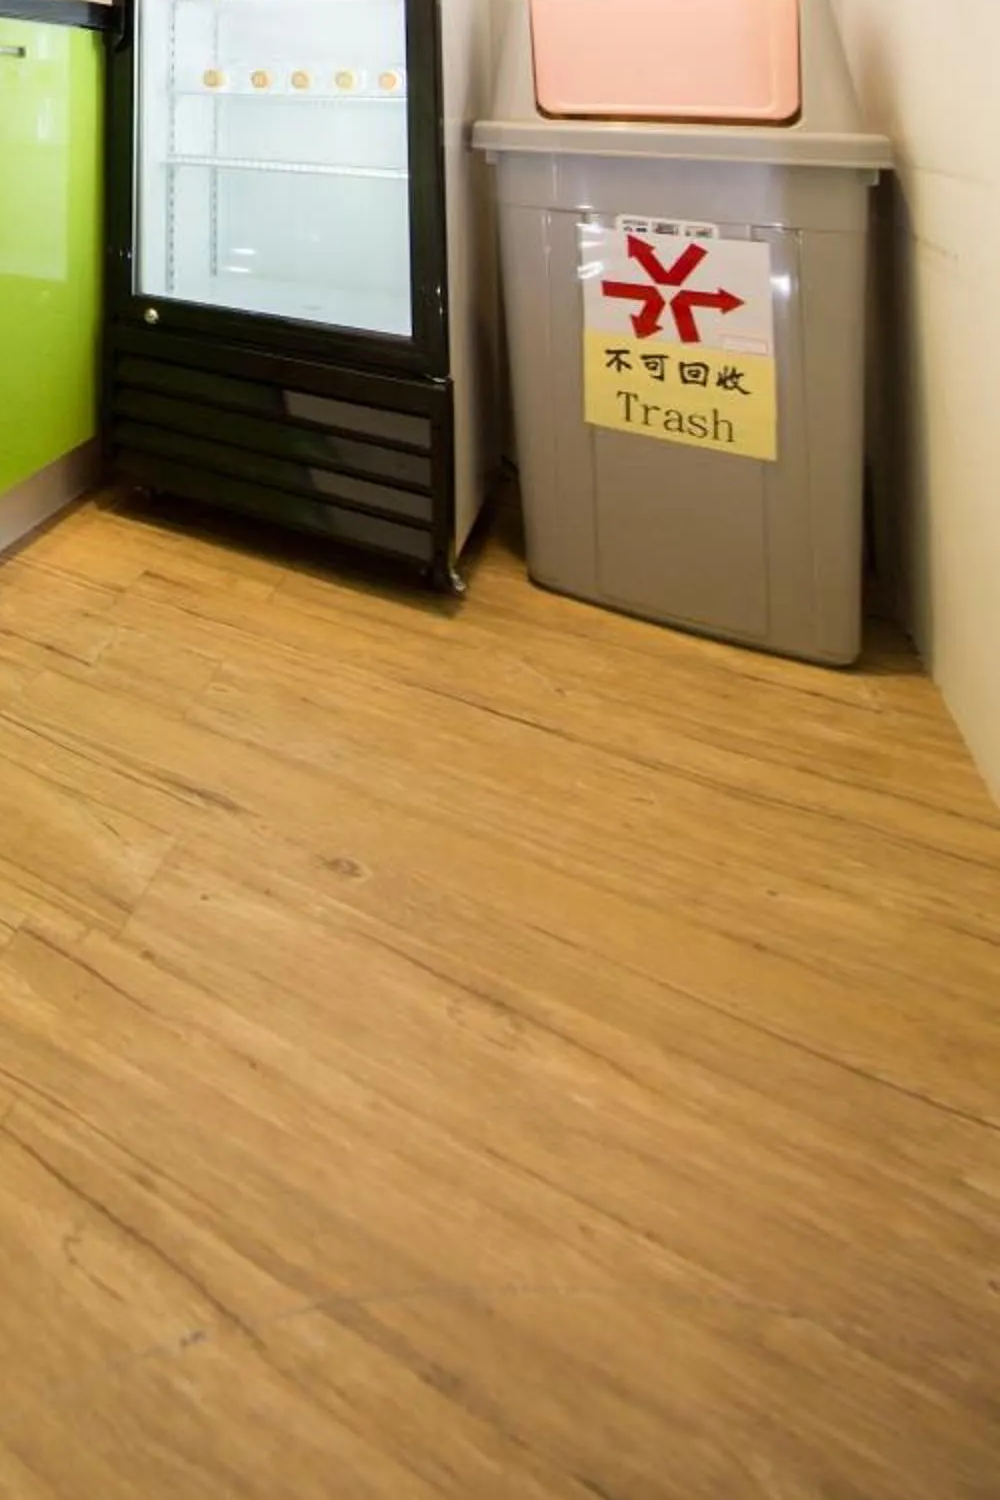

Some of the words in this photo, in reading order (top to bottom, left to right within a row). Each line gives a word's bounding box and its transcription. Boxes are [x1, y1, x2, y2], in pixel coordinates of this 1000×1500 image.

[605, 348, 752, 395] 不可回收
[617, 390, 736, 443] Trash
